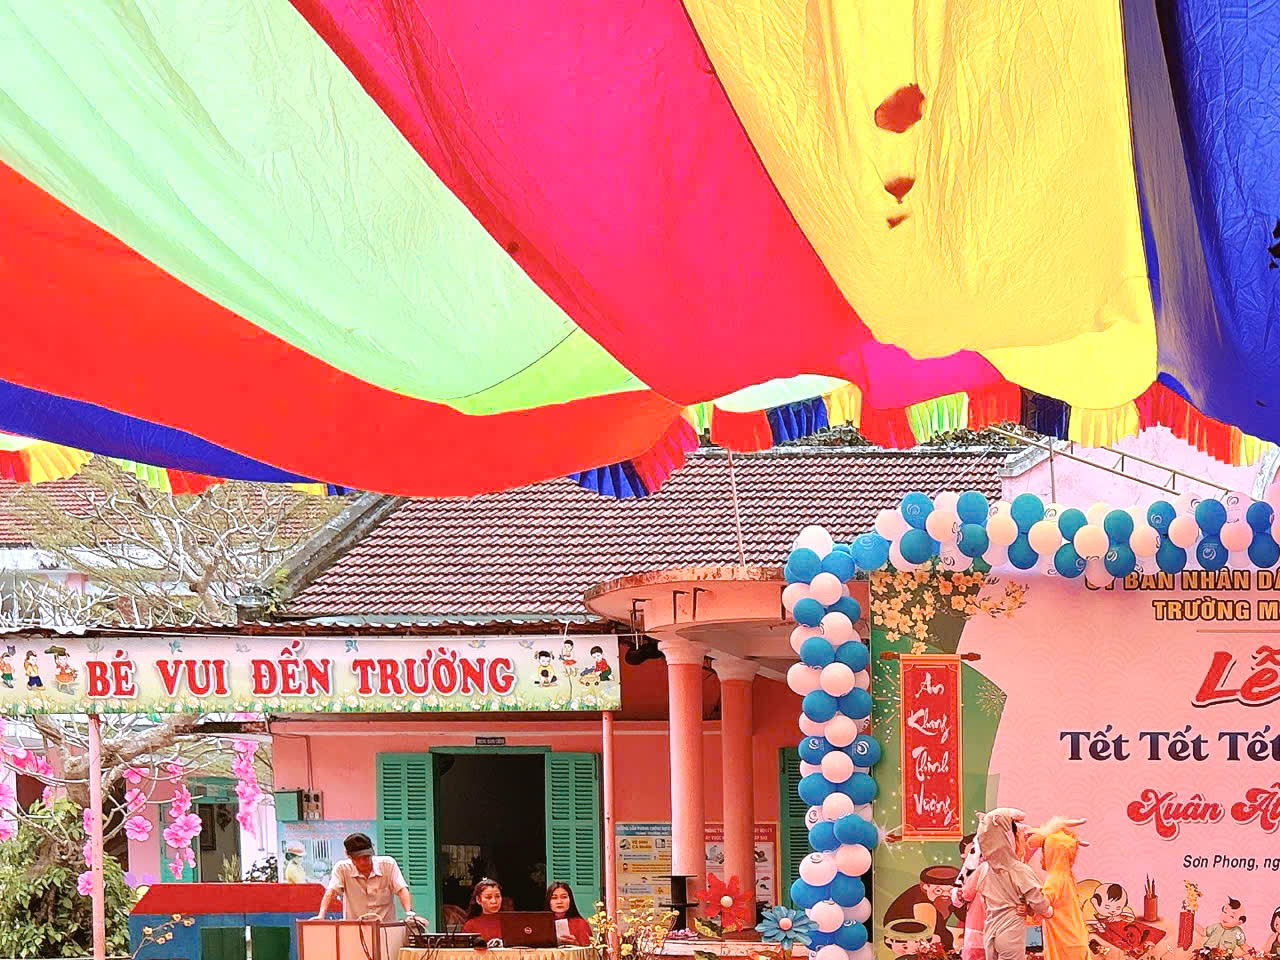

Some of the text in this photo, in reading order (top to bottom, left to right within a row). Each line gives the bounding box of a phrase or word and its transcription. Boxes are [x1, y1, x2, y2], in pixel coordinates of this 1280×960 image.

[1124, 570, 1175, 590] BAN
[1182, 566, 1250, 591] NHÂN
[1152, 594, 1251, 620] TRƯỜNG
[86, 640, 515, 698] BÉ VUI ĐẾN TRƯỜNG
[1060, 724, 1130, 761] Tết
[1139, 724, 1209, 761] Tết
[1127, 788, 1225, 840] Xuân
[1183, 854, 1208, 868] Sơn
[1213, 855, 1259, 871] Phong,
